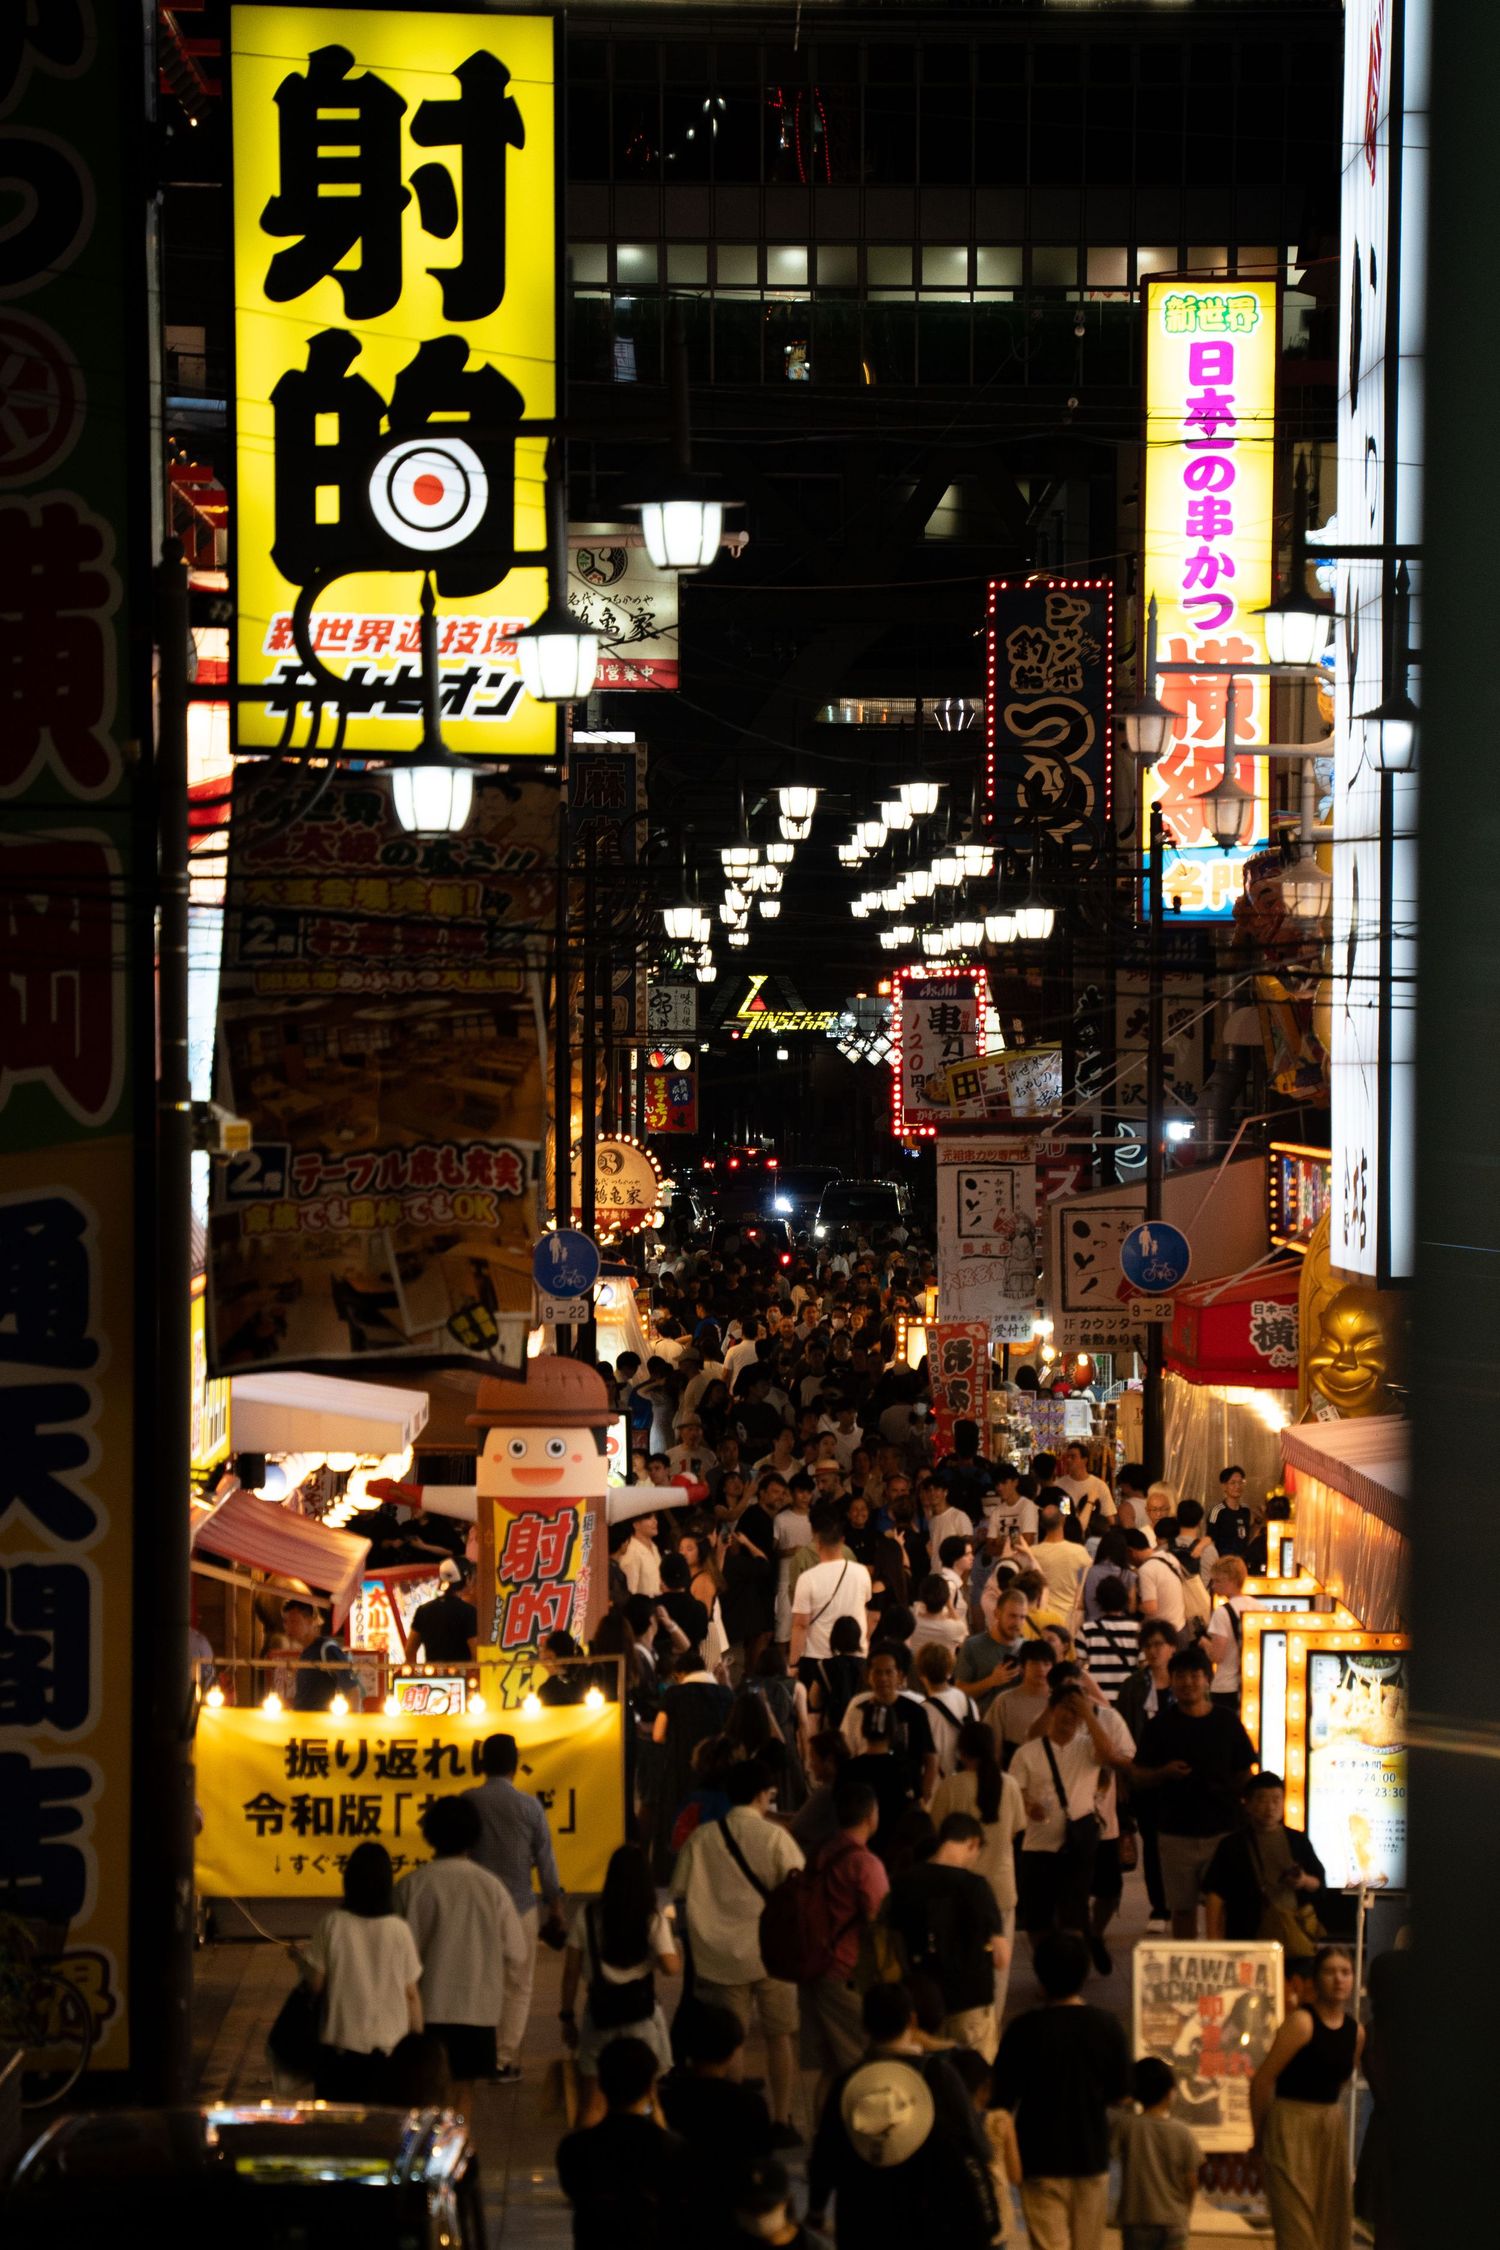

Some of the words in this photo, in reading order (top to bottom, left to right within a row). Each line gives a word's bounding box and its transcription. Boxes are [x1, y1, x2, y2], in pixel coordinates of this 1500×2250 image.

[261, 44, 525, 598] 射的
[1165, 295, 1258, 332] 新世界
[1182, 340, 1237, 631] 日本一の串かつ
[1157, 636, 1256, 847] 横綱
[919, 983, 958, 998] Asahi
[291, 1145, 519, 1192] テーブル席も充実
[545, 1307, 587, 1319] 9-22
[1132, 1304, 1172, 1317] 9-22
[1253, 1316, 1298, 1353] 横
[501, 1511, 574, 1650] 射的
